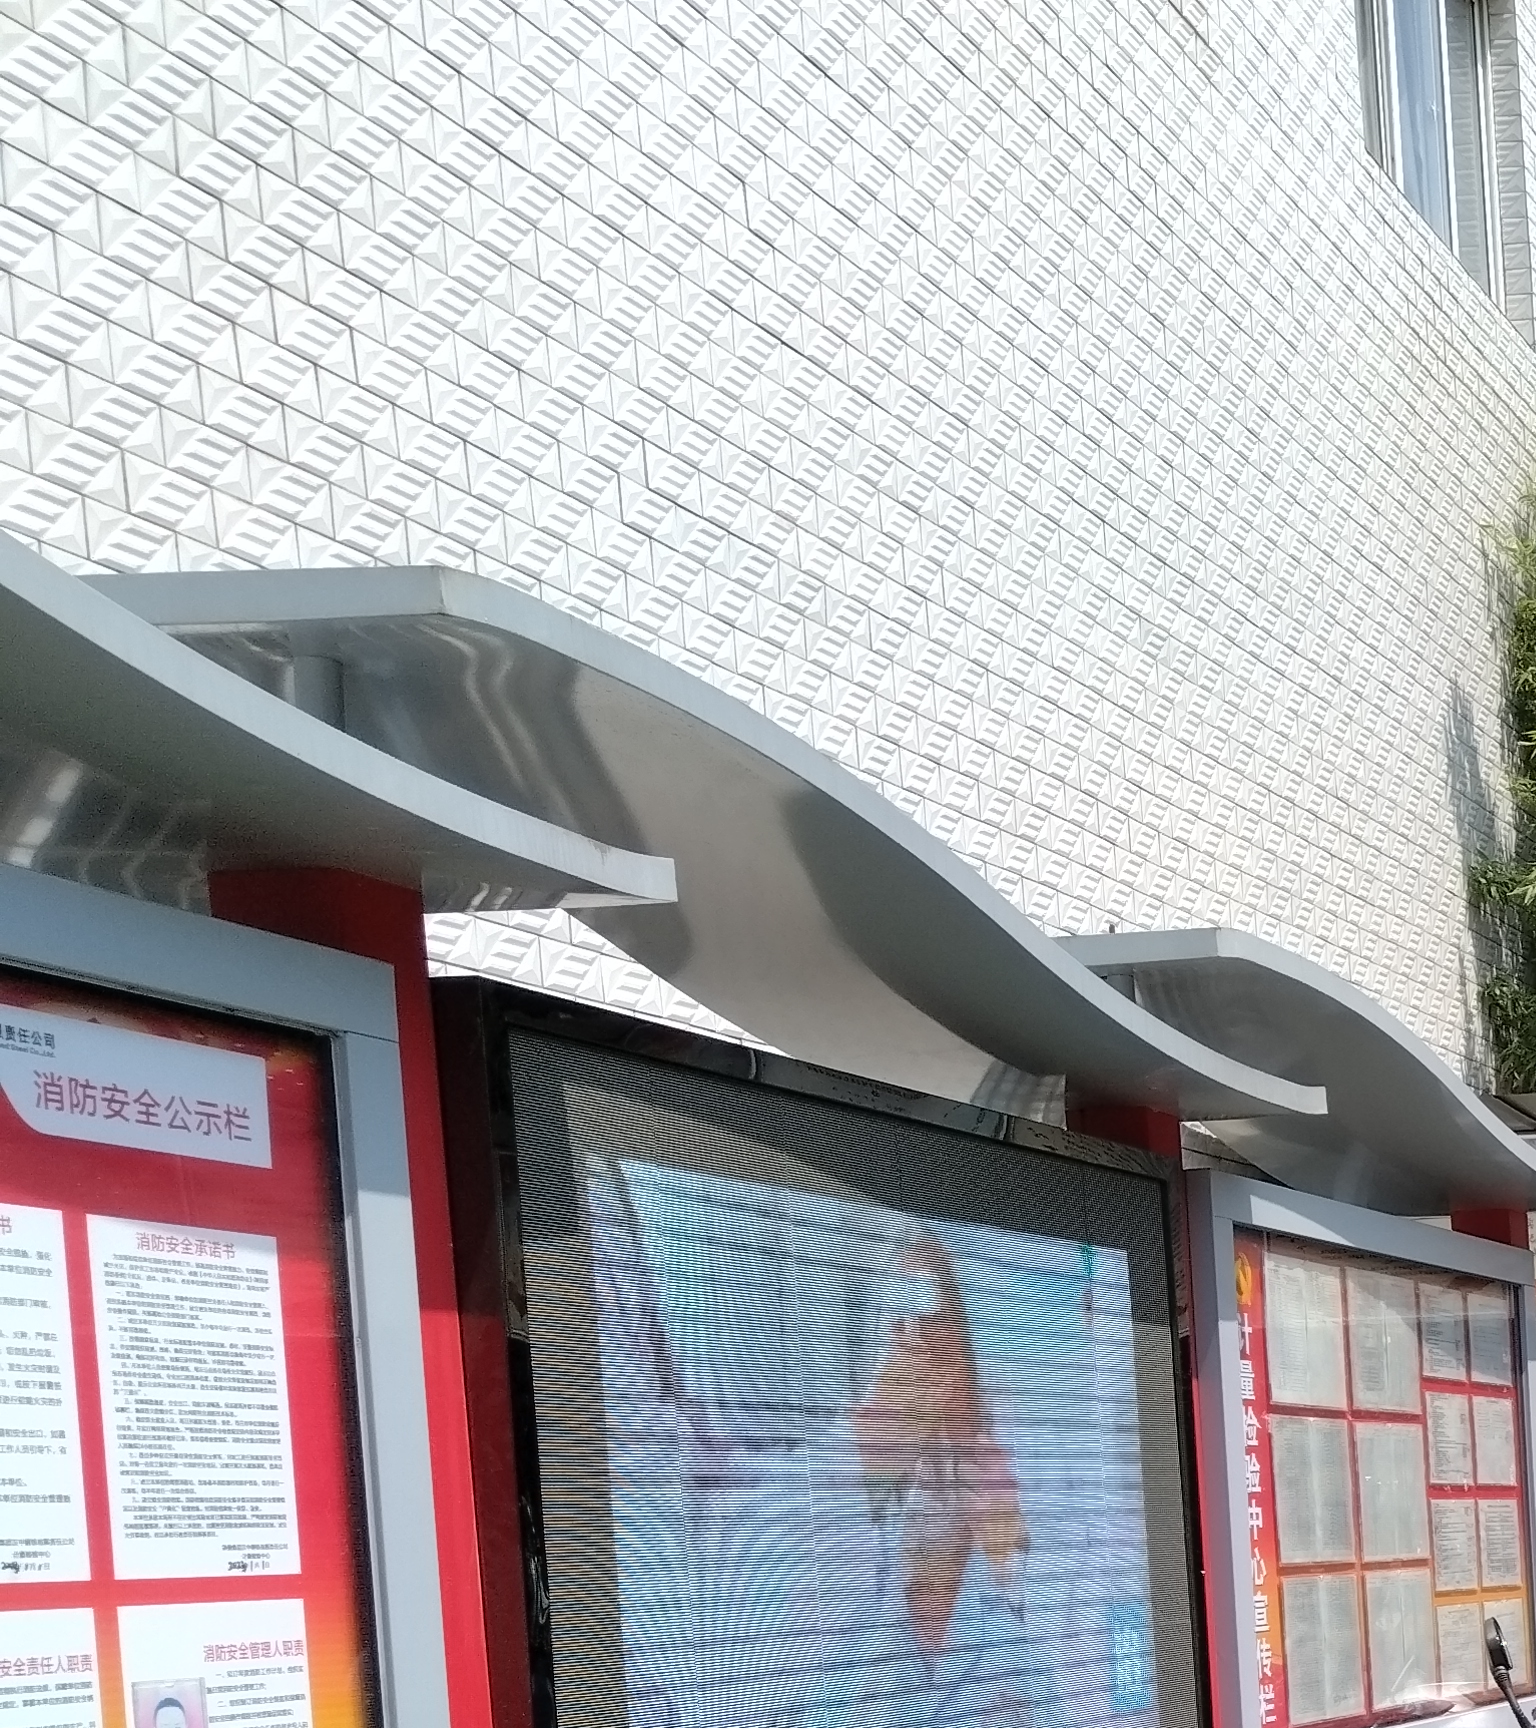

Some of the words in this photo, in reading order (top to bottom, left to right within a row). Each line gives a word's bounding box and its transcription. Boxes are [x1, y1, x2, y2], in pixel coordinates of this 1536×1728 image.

[33, 1069, 252, 1142] 消防安全公示栏
[136, 1231, 237, 1260] 消防安全承诺书
[1235, 1310, 1278, 1725] 计量检验中心宣传栏
[203, 1639, 305, 1663] 消防安全管理人职责
